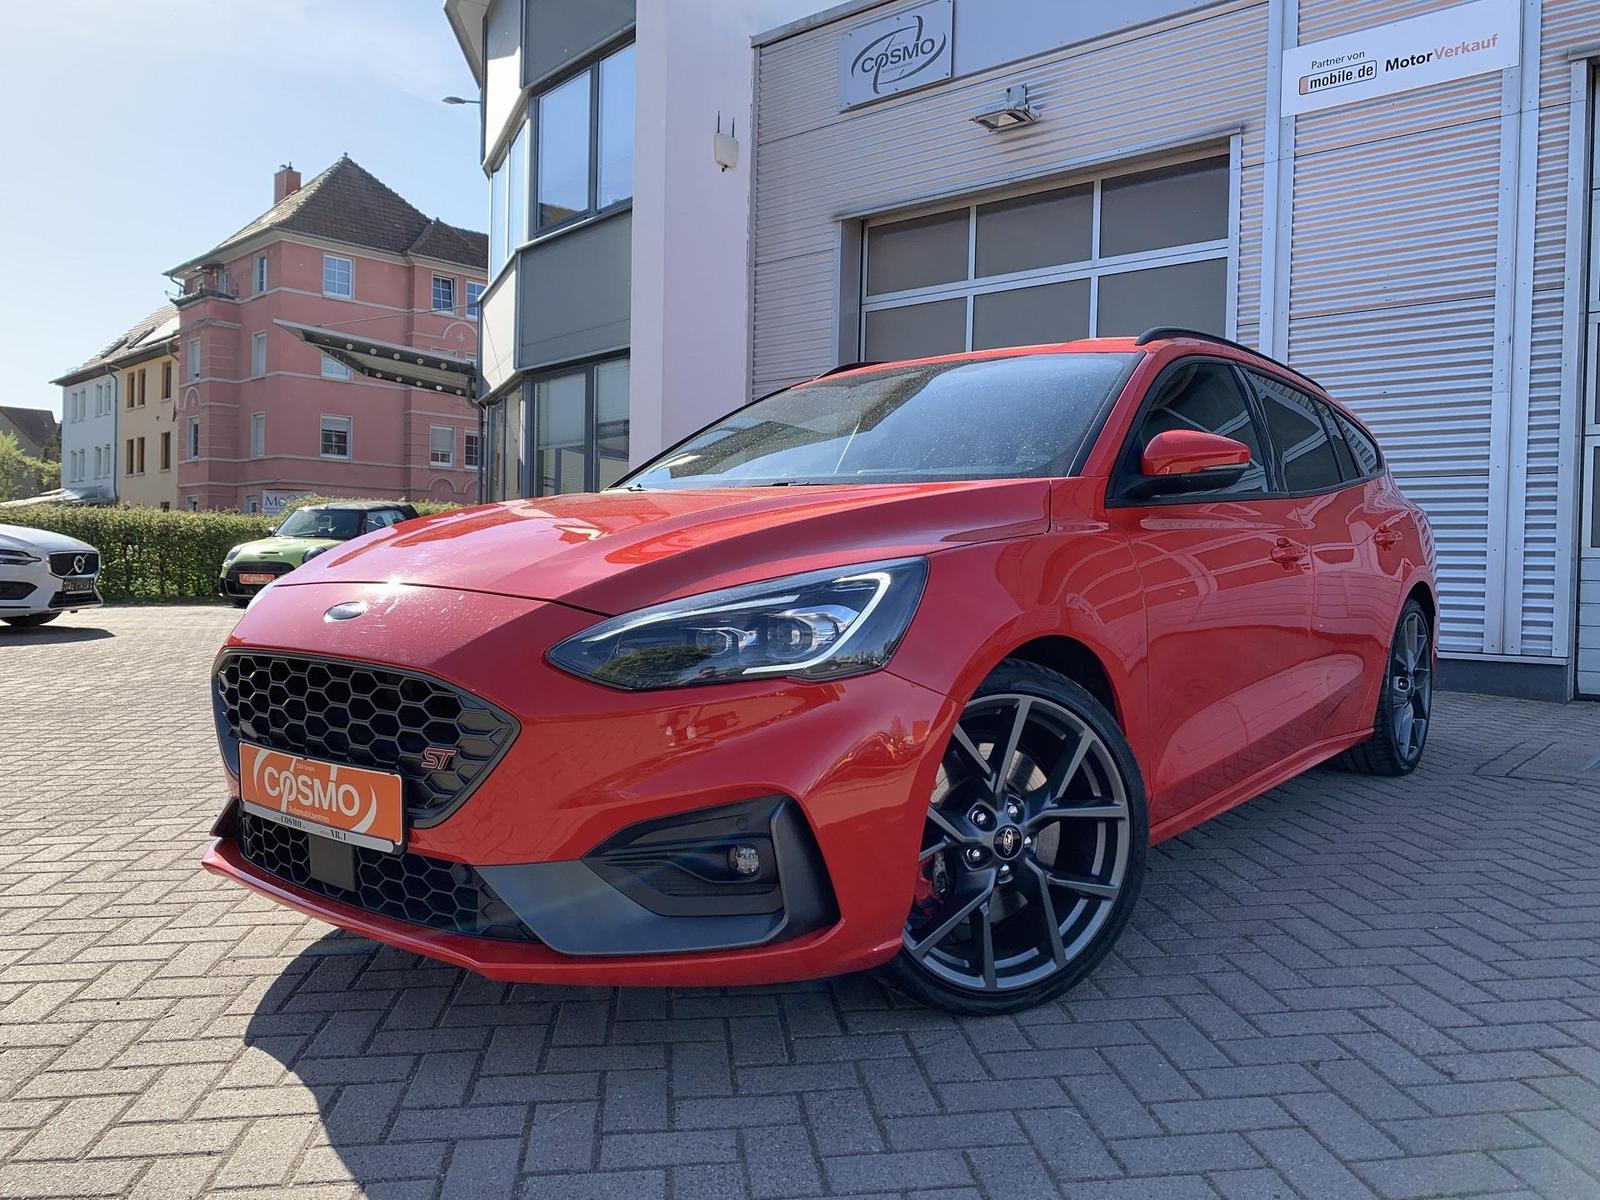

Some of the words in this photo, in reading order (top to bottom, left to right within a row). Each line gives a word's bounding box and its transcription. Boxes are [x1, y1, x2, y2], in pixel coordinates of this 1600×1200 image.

[861, 38, 935, 73] COSMO
[1311, 56, 1345, 70] Partner
[1347, 51, 1365, 60] von
[1309, 65, 1374, 90] mobile.de
[421, 747, 458, 770] ST
[264, 766, 360, 817] COSMO
